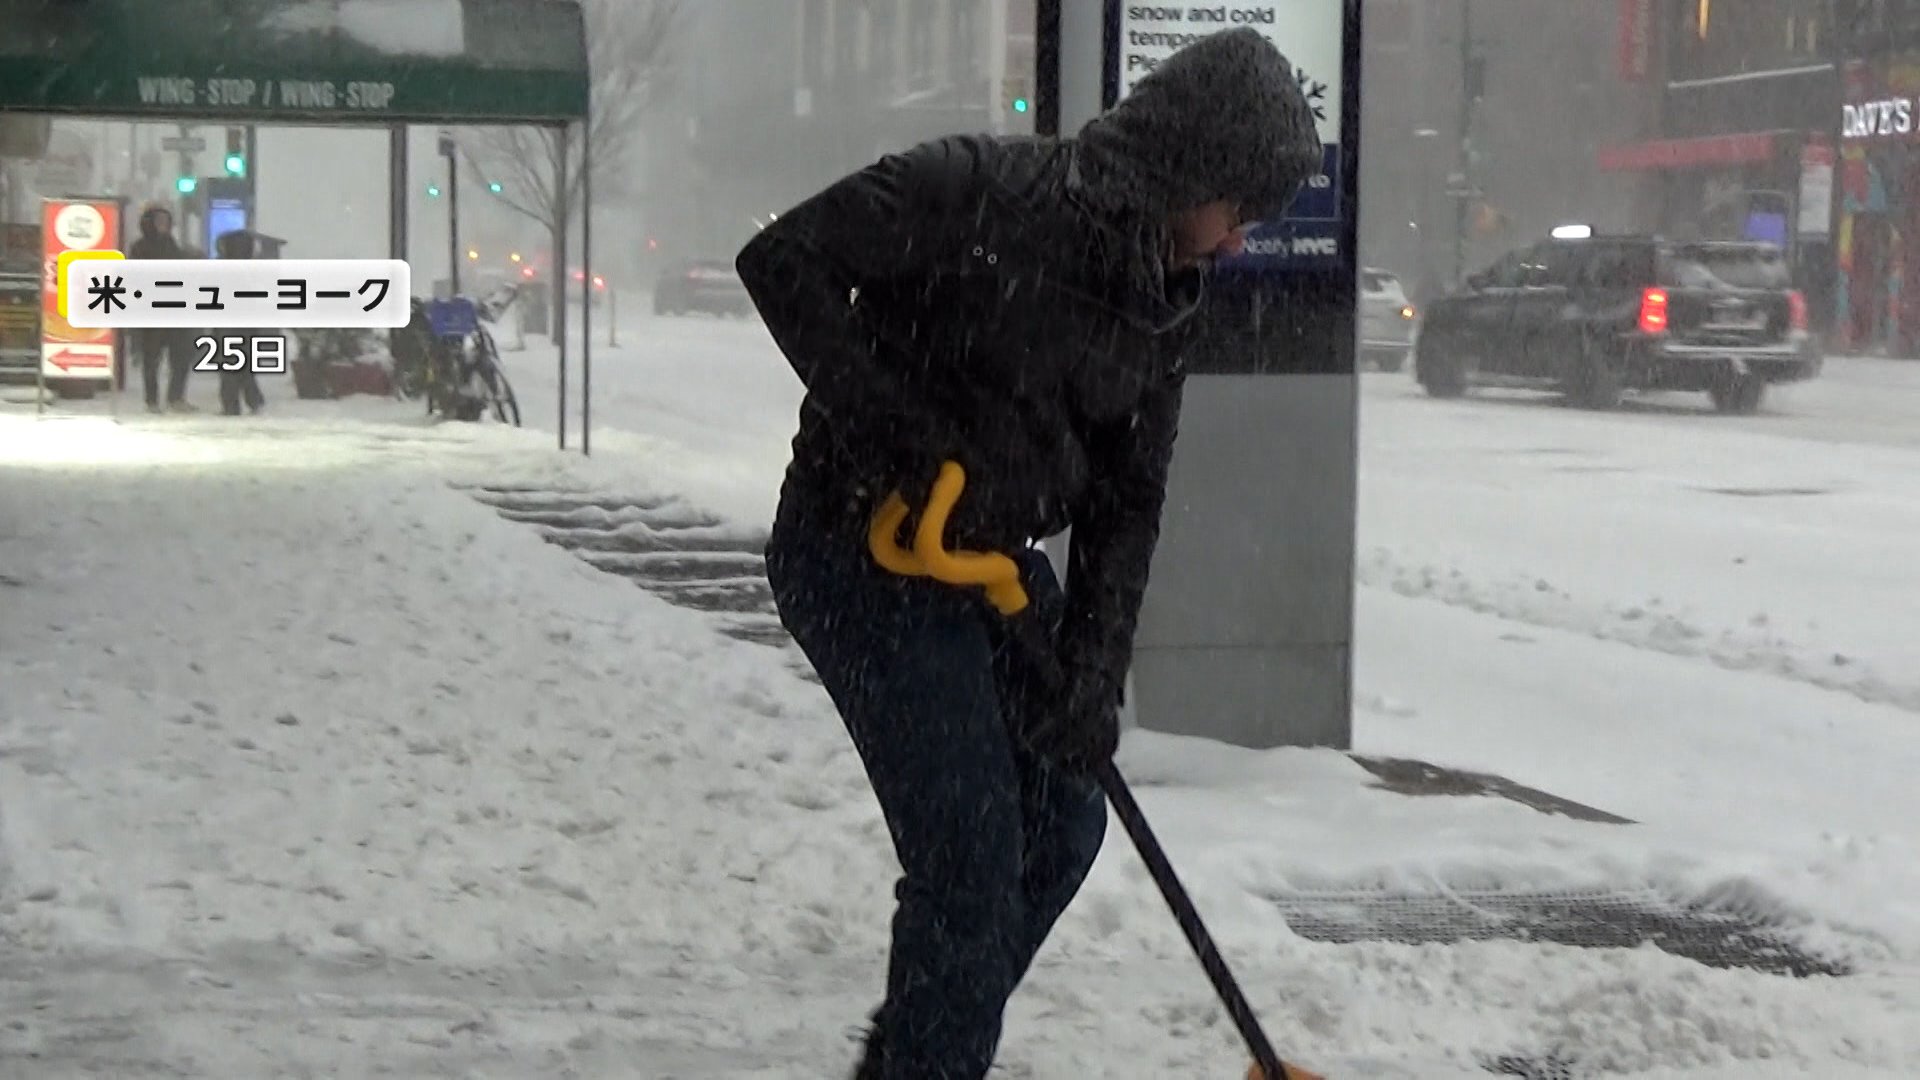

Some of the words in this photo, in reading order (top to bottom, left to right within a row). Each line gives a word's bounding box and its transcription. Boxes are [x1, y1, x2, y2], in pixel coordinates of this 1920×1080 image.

[1128, 7, 1182, 21] snow
[1188, 6, 1225, 22] and
[1230, 7, 1275, 23] cold
[1842, 97, 1911, 137] DAVE'S
[1243, 237, 1288, 257] Notify
[1292, 237, 1338, 255] NYC
